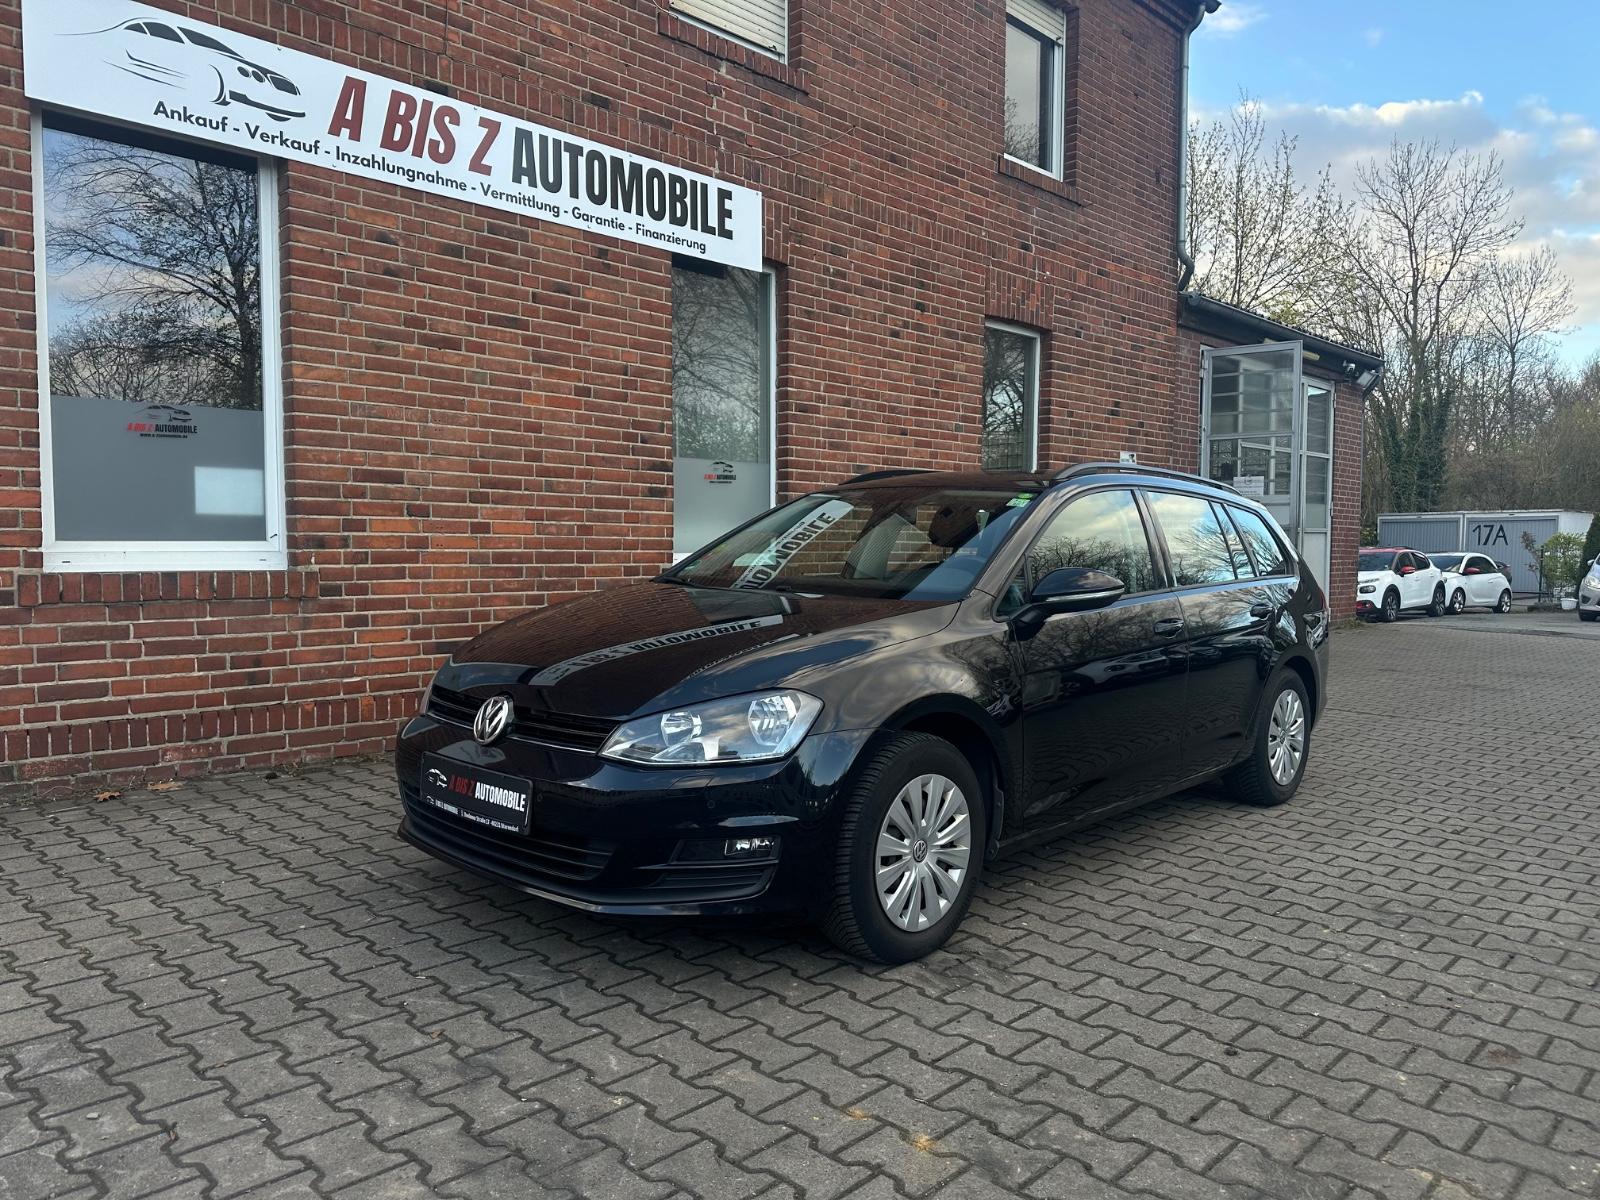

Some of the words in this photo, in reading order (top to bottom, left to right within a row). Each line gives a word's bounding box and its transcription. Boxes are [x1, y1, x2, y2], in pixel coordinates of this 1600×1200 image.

[327, 75, 367, 142] A
[379, 89, 461, 165] BIS
[468, 116, 502, 176] Z
[511, 126, 734, 240] AUTOMOBILE
[153, 100, 228, 133] Ankauf
[245, 122, 320, 155] Verkauf
[335, 145, 467, 191] Inzahlungnahme
[480, 182, 560, 218] Vermittlung
[571, 206, 625, 231] Garantie
[635, 223, 706, 254] Finanzierung
[154, 423, 198, 434] AUTOMOBILE
[1472, 524, 1509, 546] 17A
[475, 781, 526, 812] AUTOMOBILE
